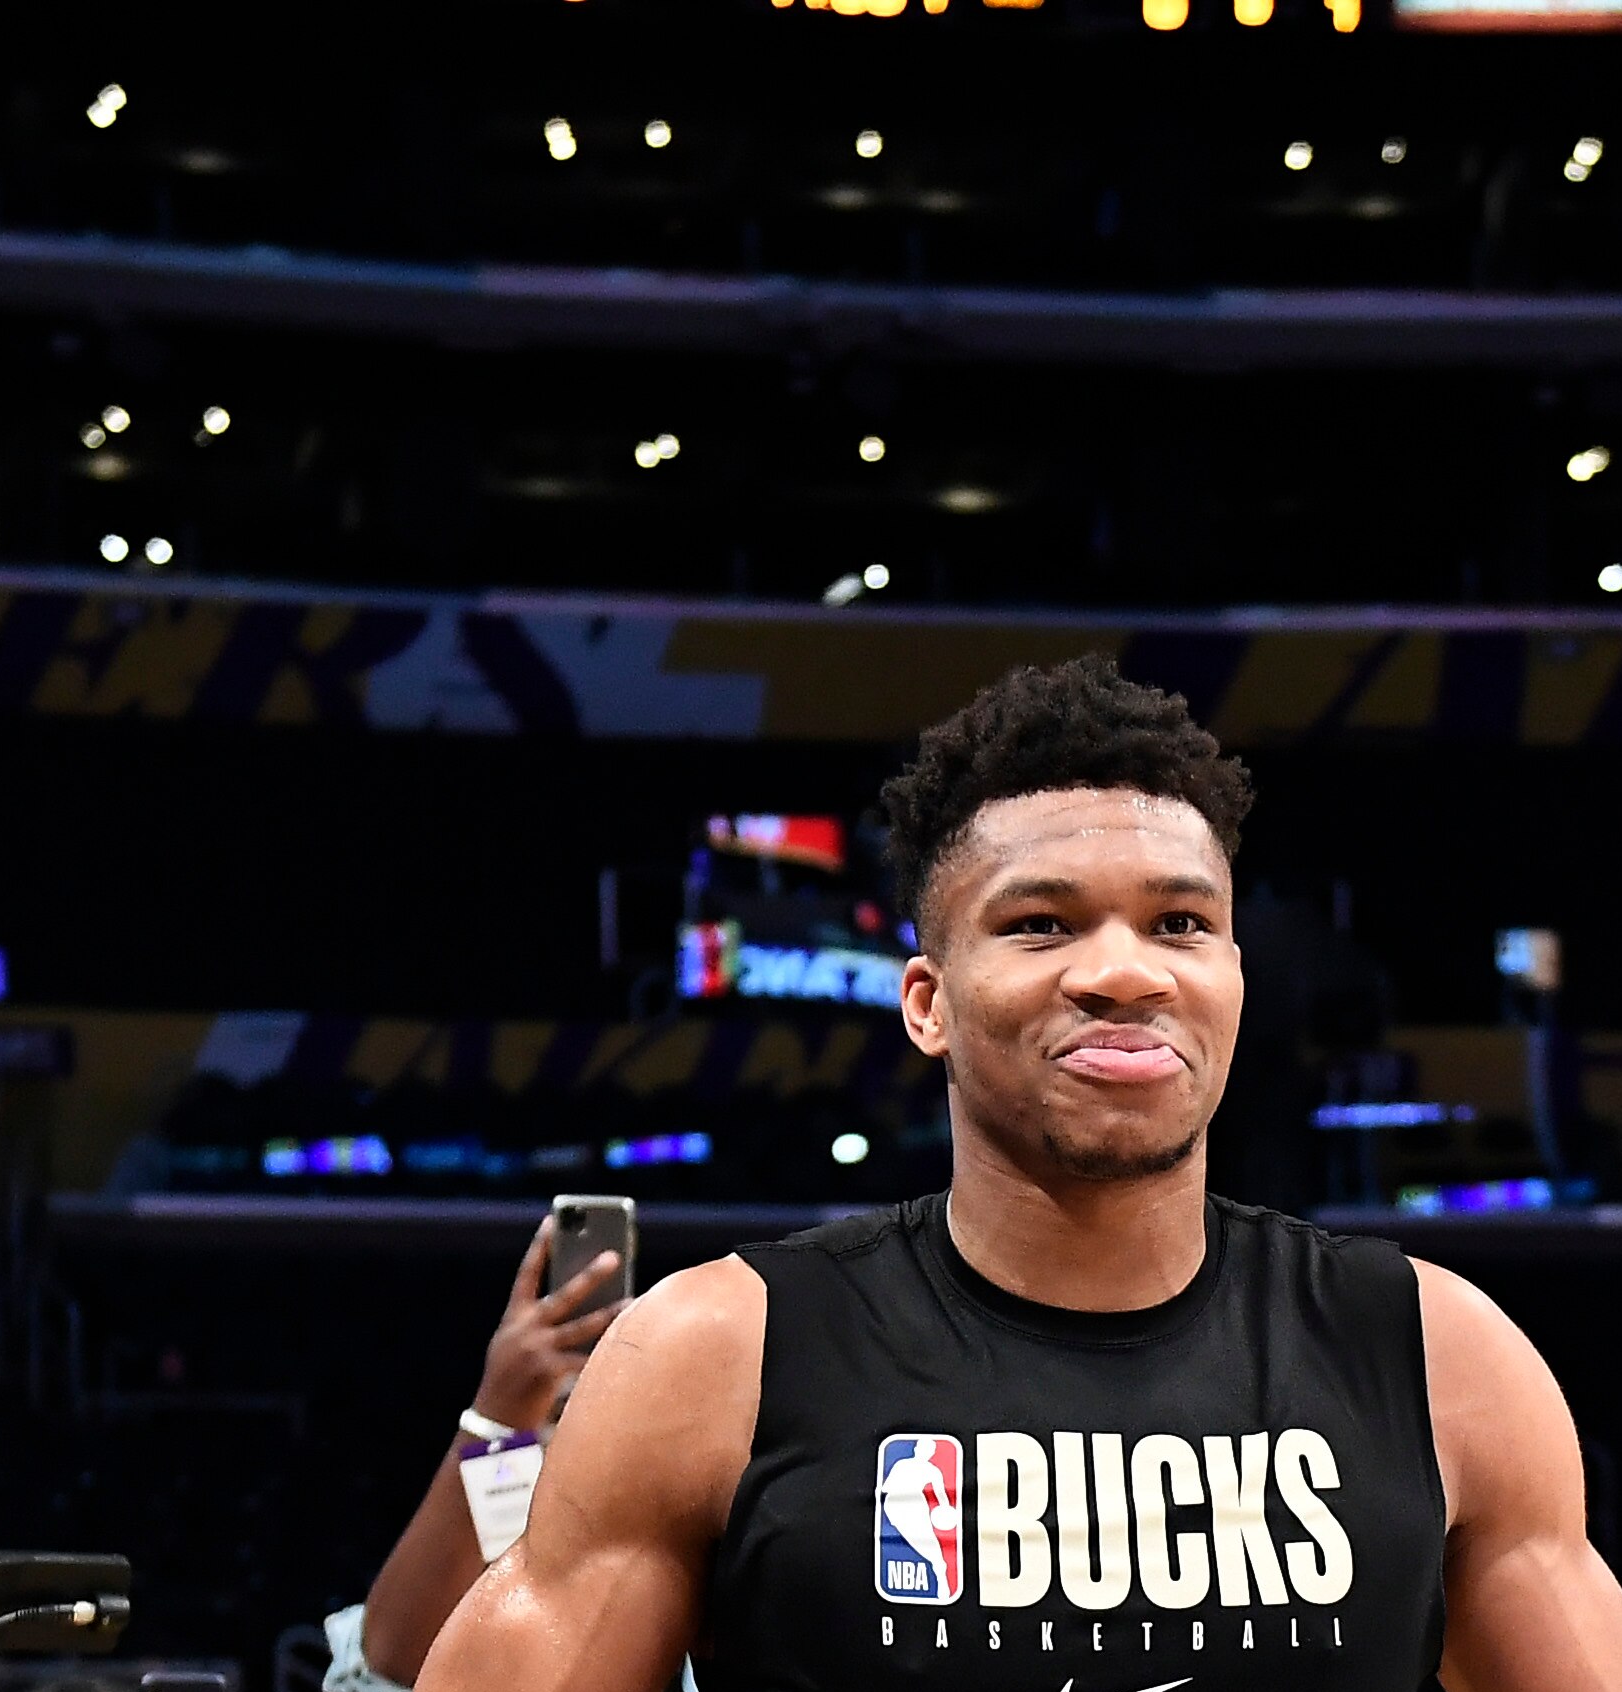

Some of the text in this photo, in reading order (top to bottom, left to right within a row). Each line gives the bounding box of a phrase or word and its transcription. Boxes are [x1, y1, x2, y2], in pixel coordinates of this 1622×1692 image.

[976, 1427, 1355, 1611] BUCKS
[887, 1560, 929, 1592] NBA
[880, 1615, 1344, 1652] BASKETBALL
